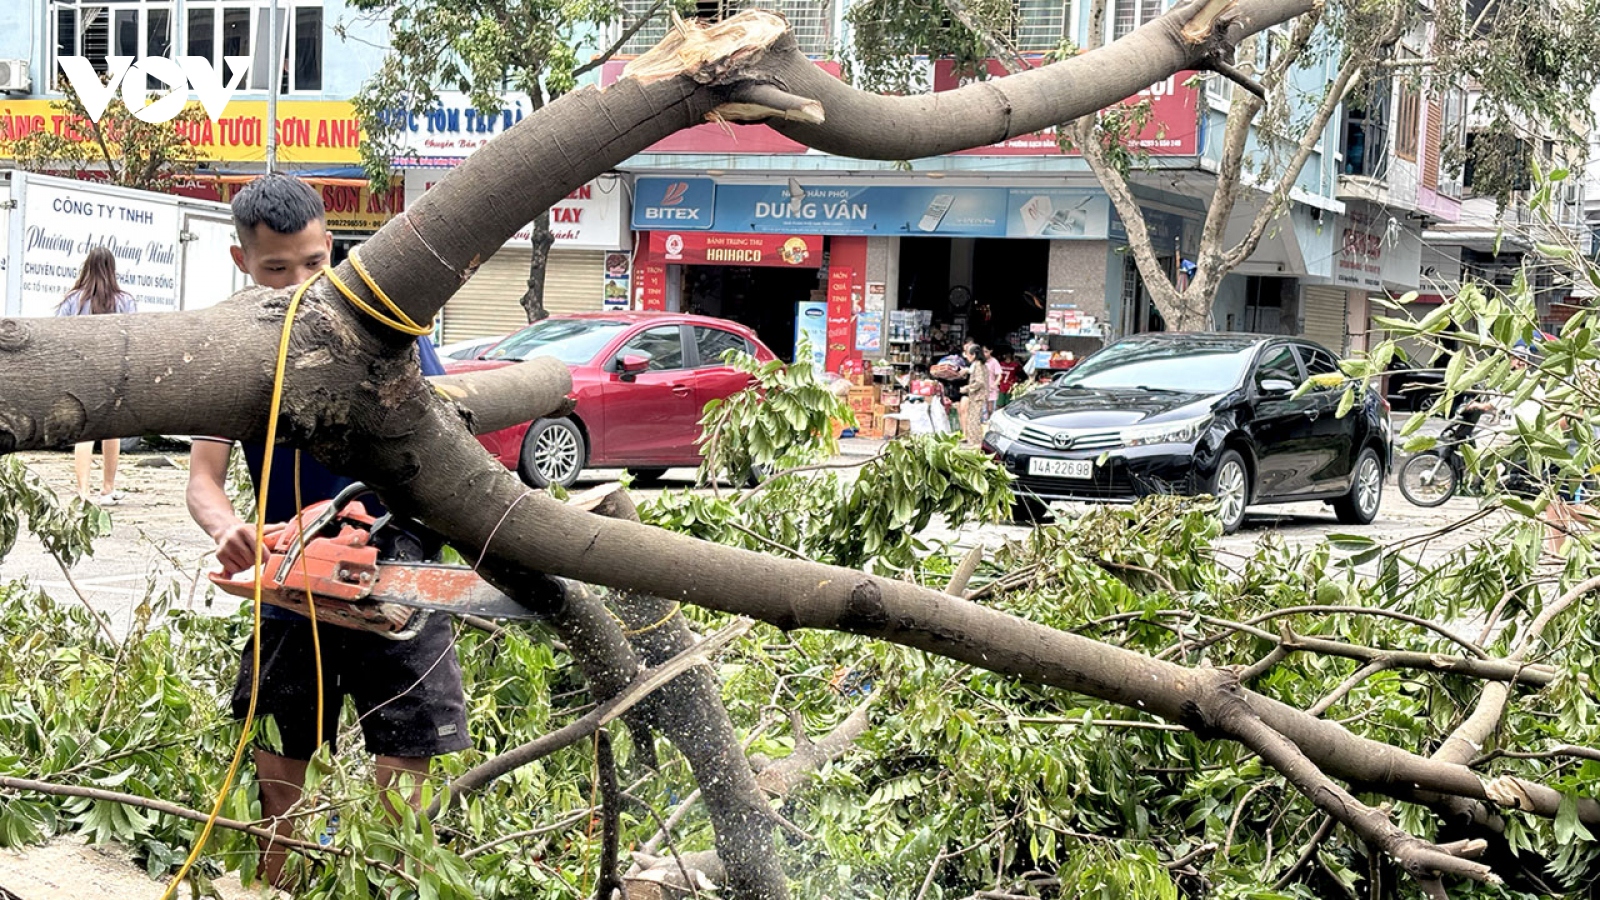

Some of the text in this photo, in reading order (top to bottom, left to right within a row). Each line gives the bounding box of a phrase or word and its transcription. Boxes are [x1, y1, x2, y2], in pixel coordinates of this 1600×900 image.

[0, 108, 46, 141] ÀNG
[218, 115, 262, 147] TƯƠI
[316, 119, 360, 148] ANH
[53, 196, 154, 225] CÔNG TY TNHH
[552, 208, 583, 223] TAY
[645, 207, 700, 220] BITEX
[823, 199, 868, 220] VÂN
[550, 229, 580, 240] hách!
[706, 248, 762, 262] HAIHACO
[1001, 370, 1011, 384] 7
